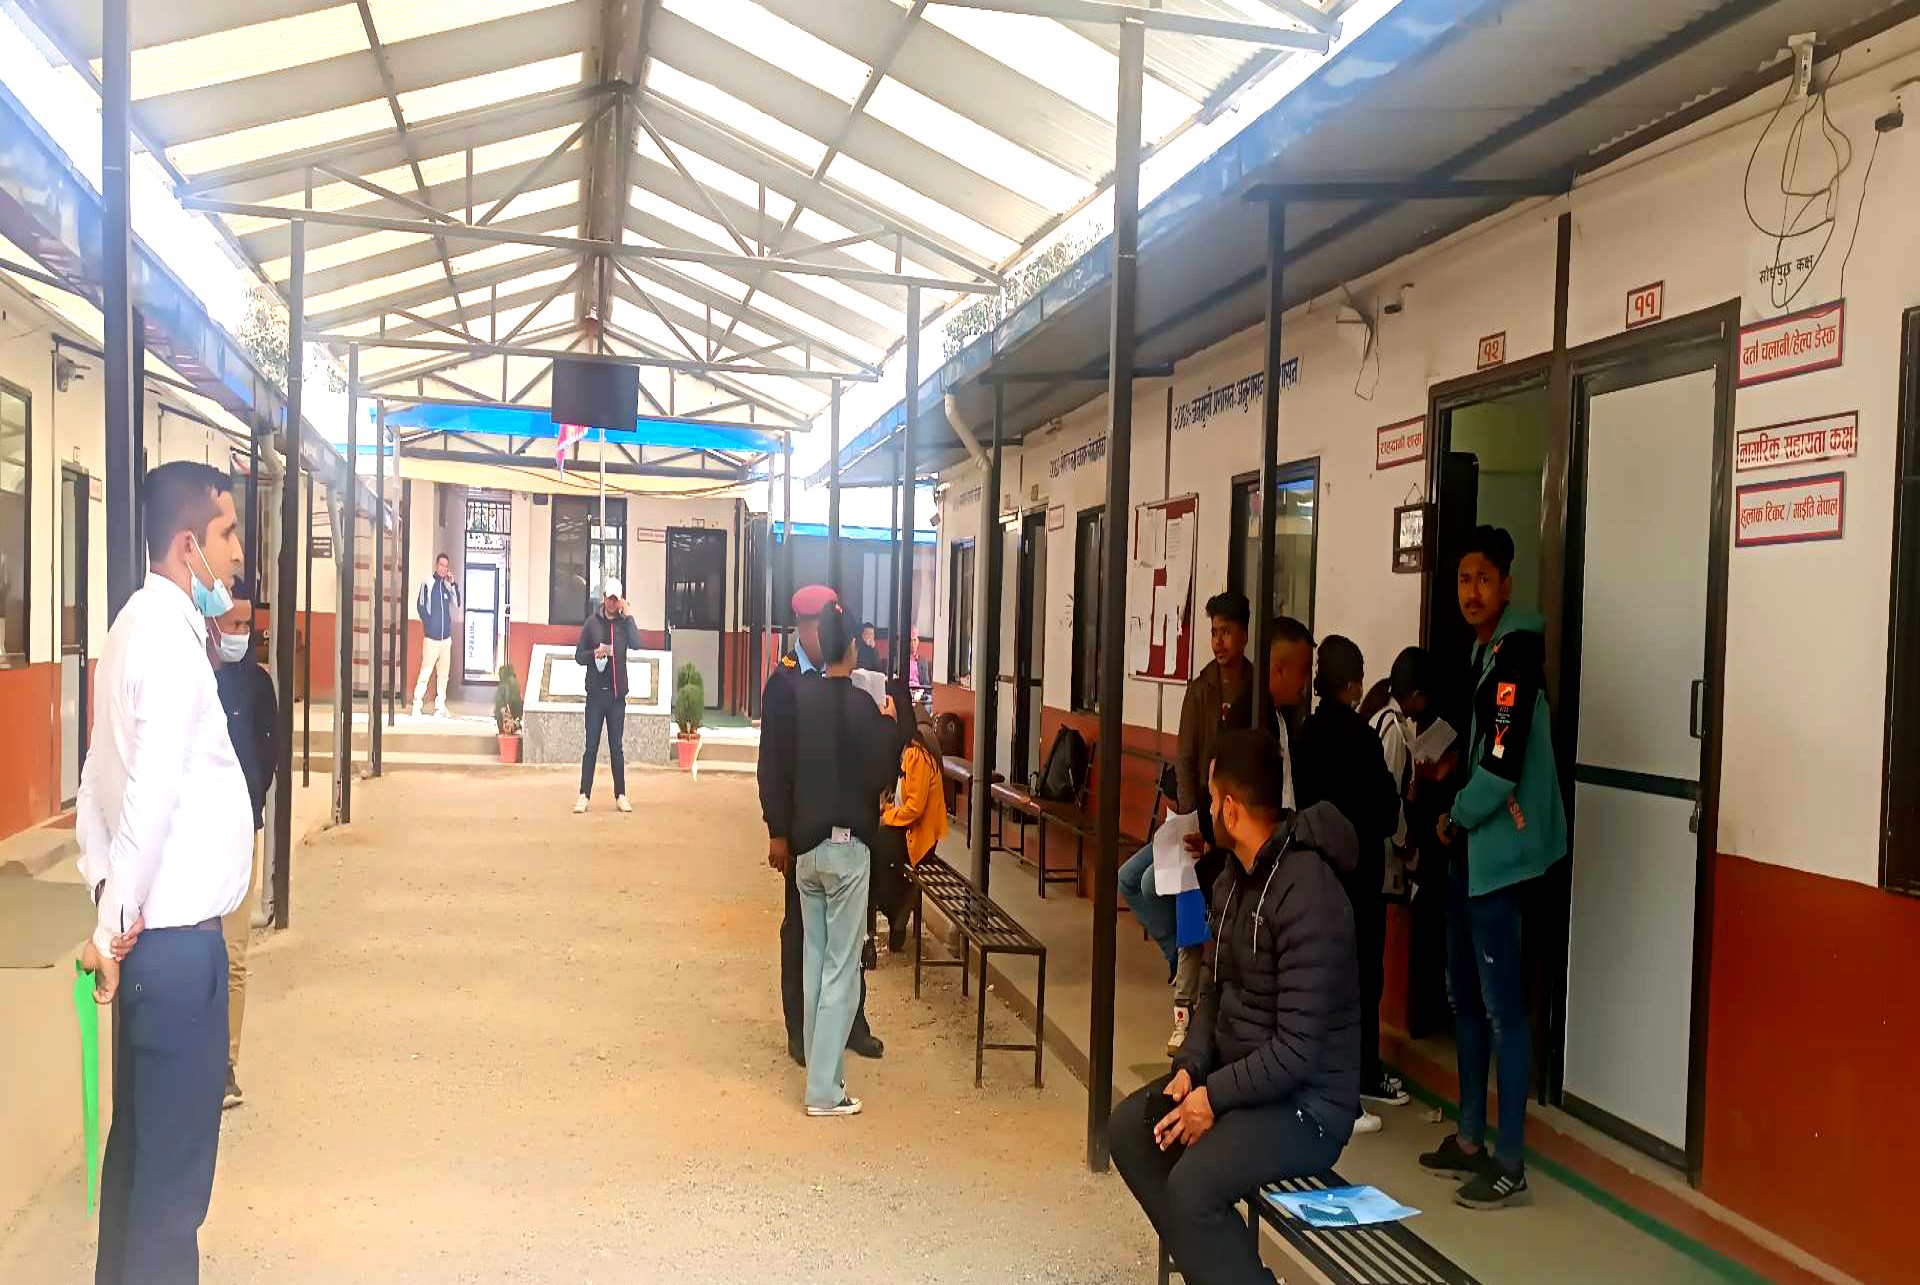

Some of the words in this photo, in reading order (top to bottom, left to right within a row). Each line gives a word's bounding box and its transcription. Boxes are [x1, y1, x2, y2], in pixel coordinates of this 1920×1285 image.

[1796, 254, 1814, 271] कक्ष
[1634, 292, 1655, 317] ११
[1739, 432, 1780, 464] नागरिक
[1784, 430, 1826, 459] सहायता
[1829, 426, 1855, 451] कक्ष
[1816, 494, 1838, 516] नेपाल
